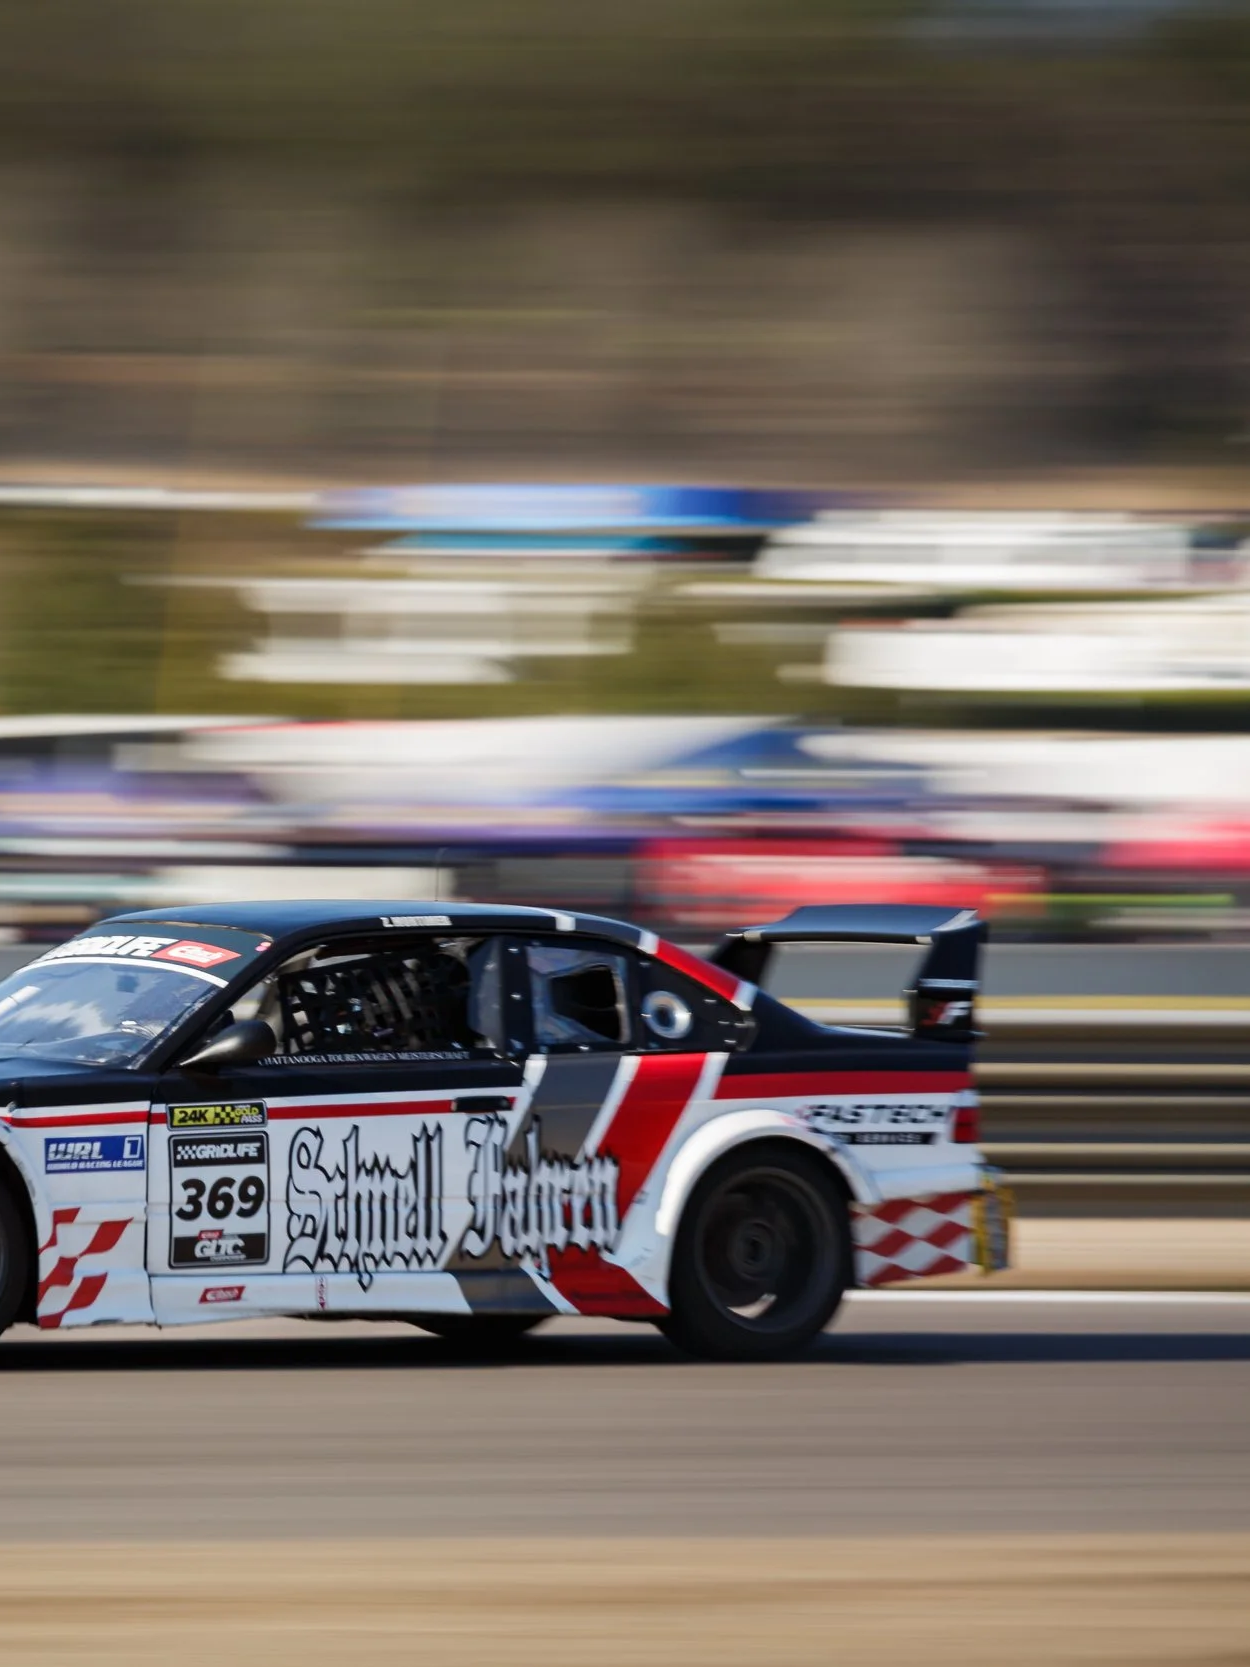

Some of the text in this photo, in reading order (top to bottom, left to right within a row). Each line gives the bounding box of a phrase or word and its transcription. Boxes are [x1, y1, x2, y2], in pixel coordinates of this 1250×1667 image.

[178, 1108, 209, 1124] 24K
[234, 1106, 259, 1117] GOLD
[241, 1114, 263, 1124] PASS
[47, 1141, 104, 1161] WRL
[195, 1142, 261, 1159] GRIDLIFE
[175, 1175, 265, 1221] 369
